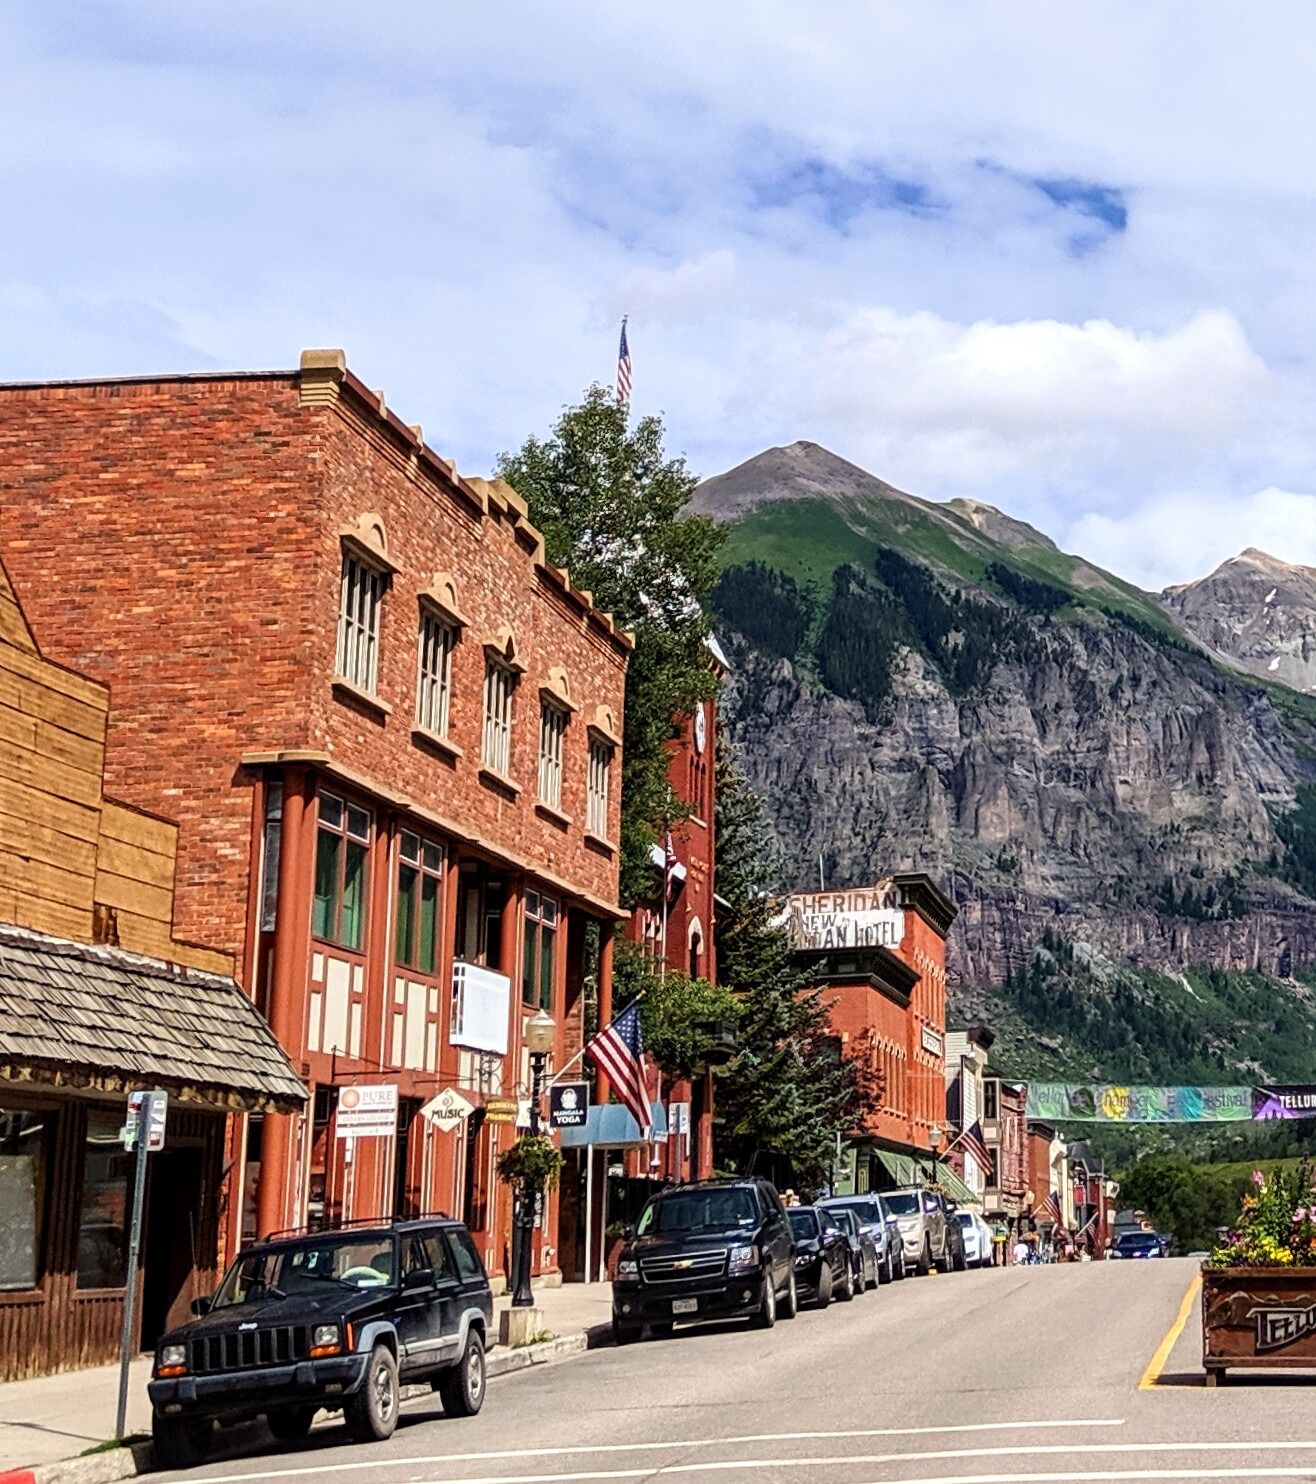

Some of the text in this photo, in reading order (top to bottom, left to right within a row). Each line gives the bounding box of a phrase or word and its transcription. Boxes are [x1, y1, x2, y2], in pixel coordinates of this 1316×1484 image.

[790, 891, 897, 915] SHERIDAN
[855, 920, 898, 946] HOTEL
[362, 1090, 393, 1103] PURE
[431, 1108, 465, 1120] MUSIC
[556, 1115, 581, 1125] YOGA
